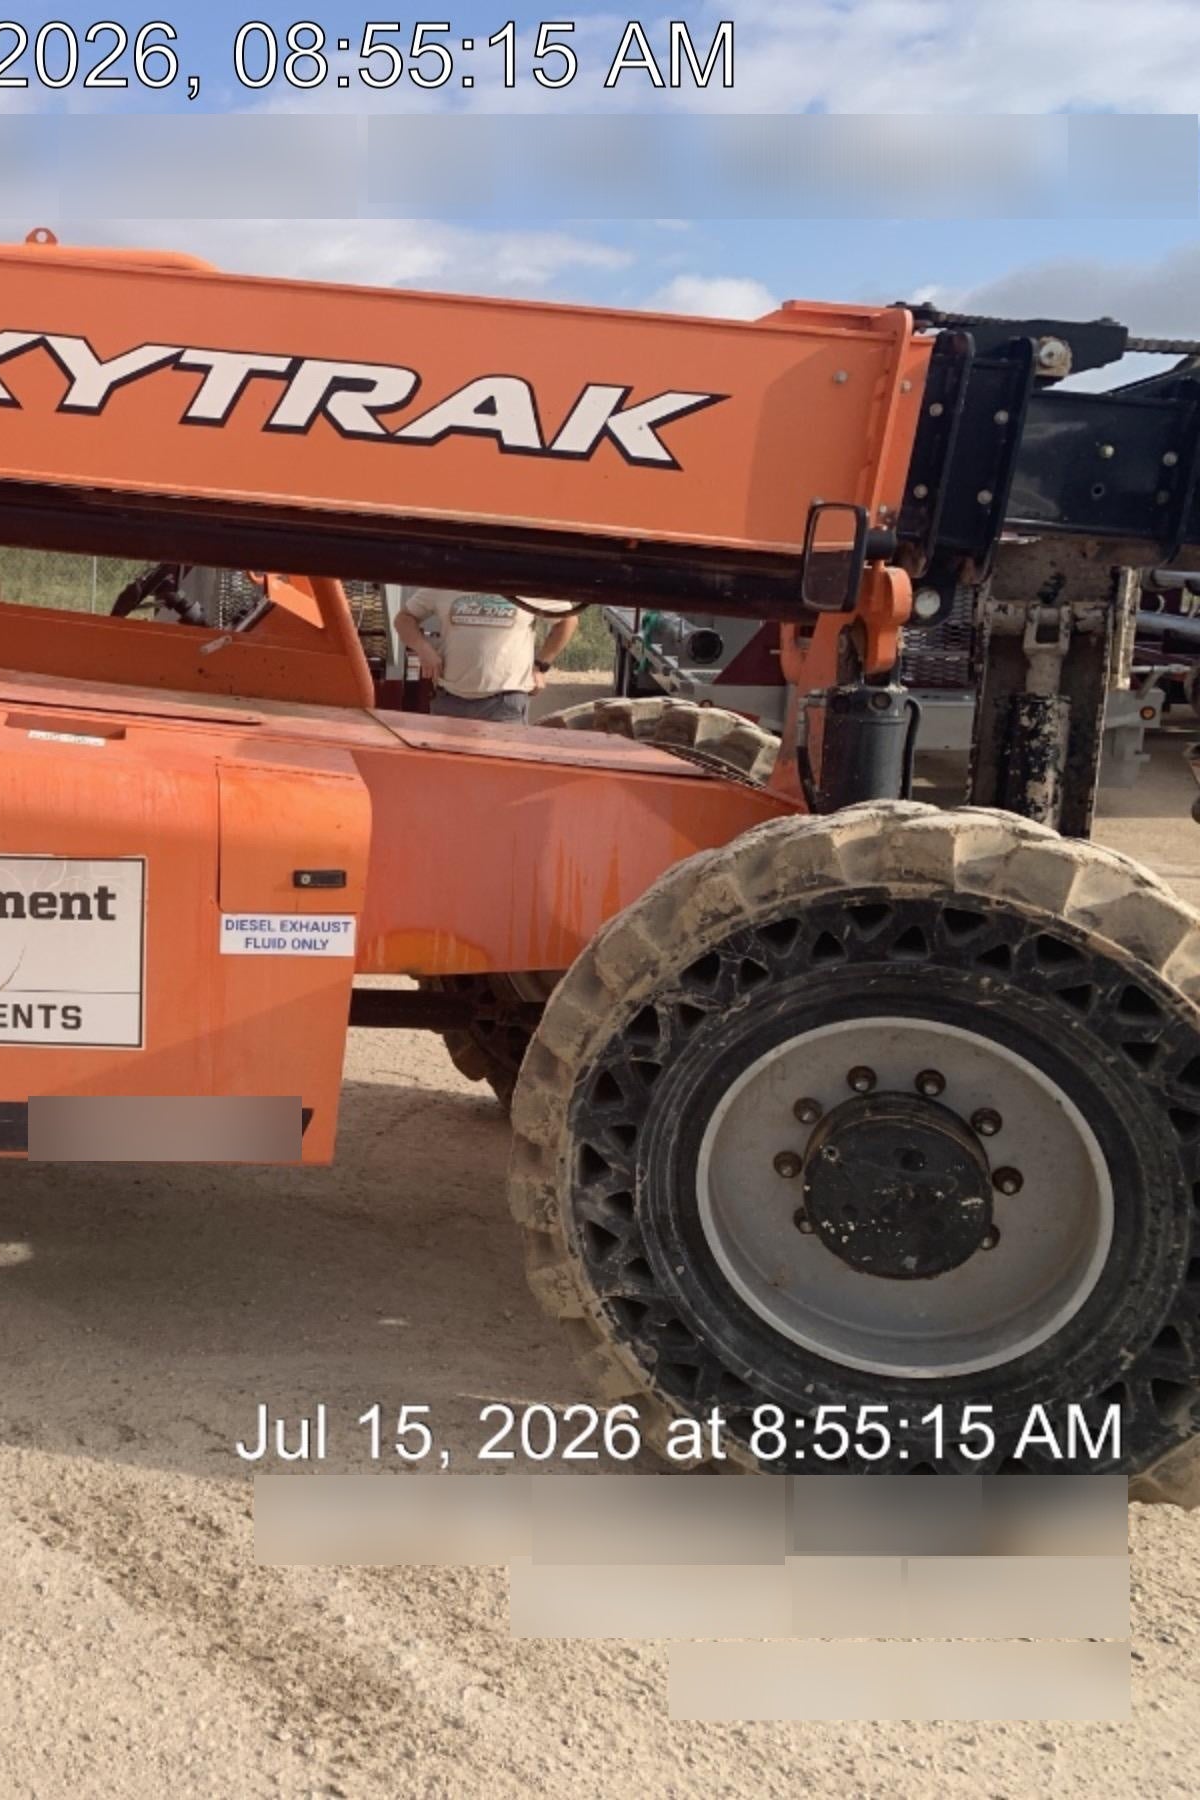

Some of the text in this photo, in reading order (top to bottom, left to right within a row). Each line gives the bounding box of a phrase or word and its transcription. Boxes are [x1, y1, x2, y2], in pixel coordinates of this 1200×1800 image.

[225, 919, 352, 933] DIESEL EXHAUST
[244, 937, 329, 950] FLUID ONLY
